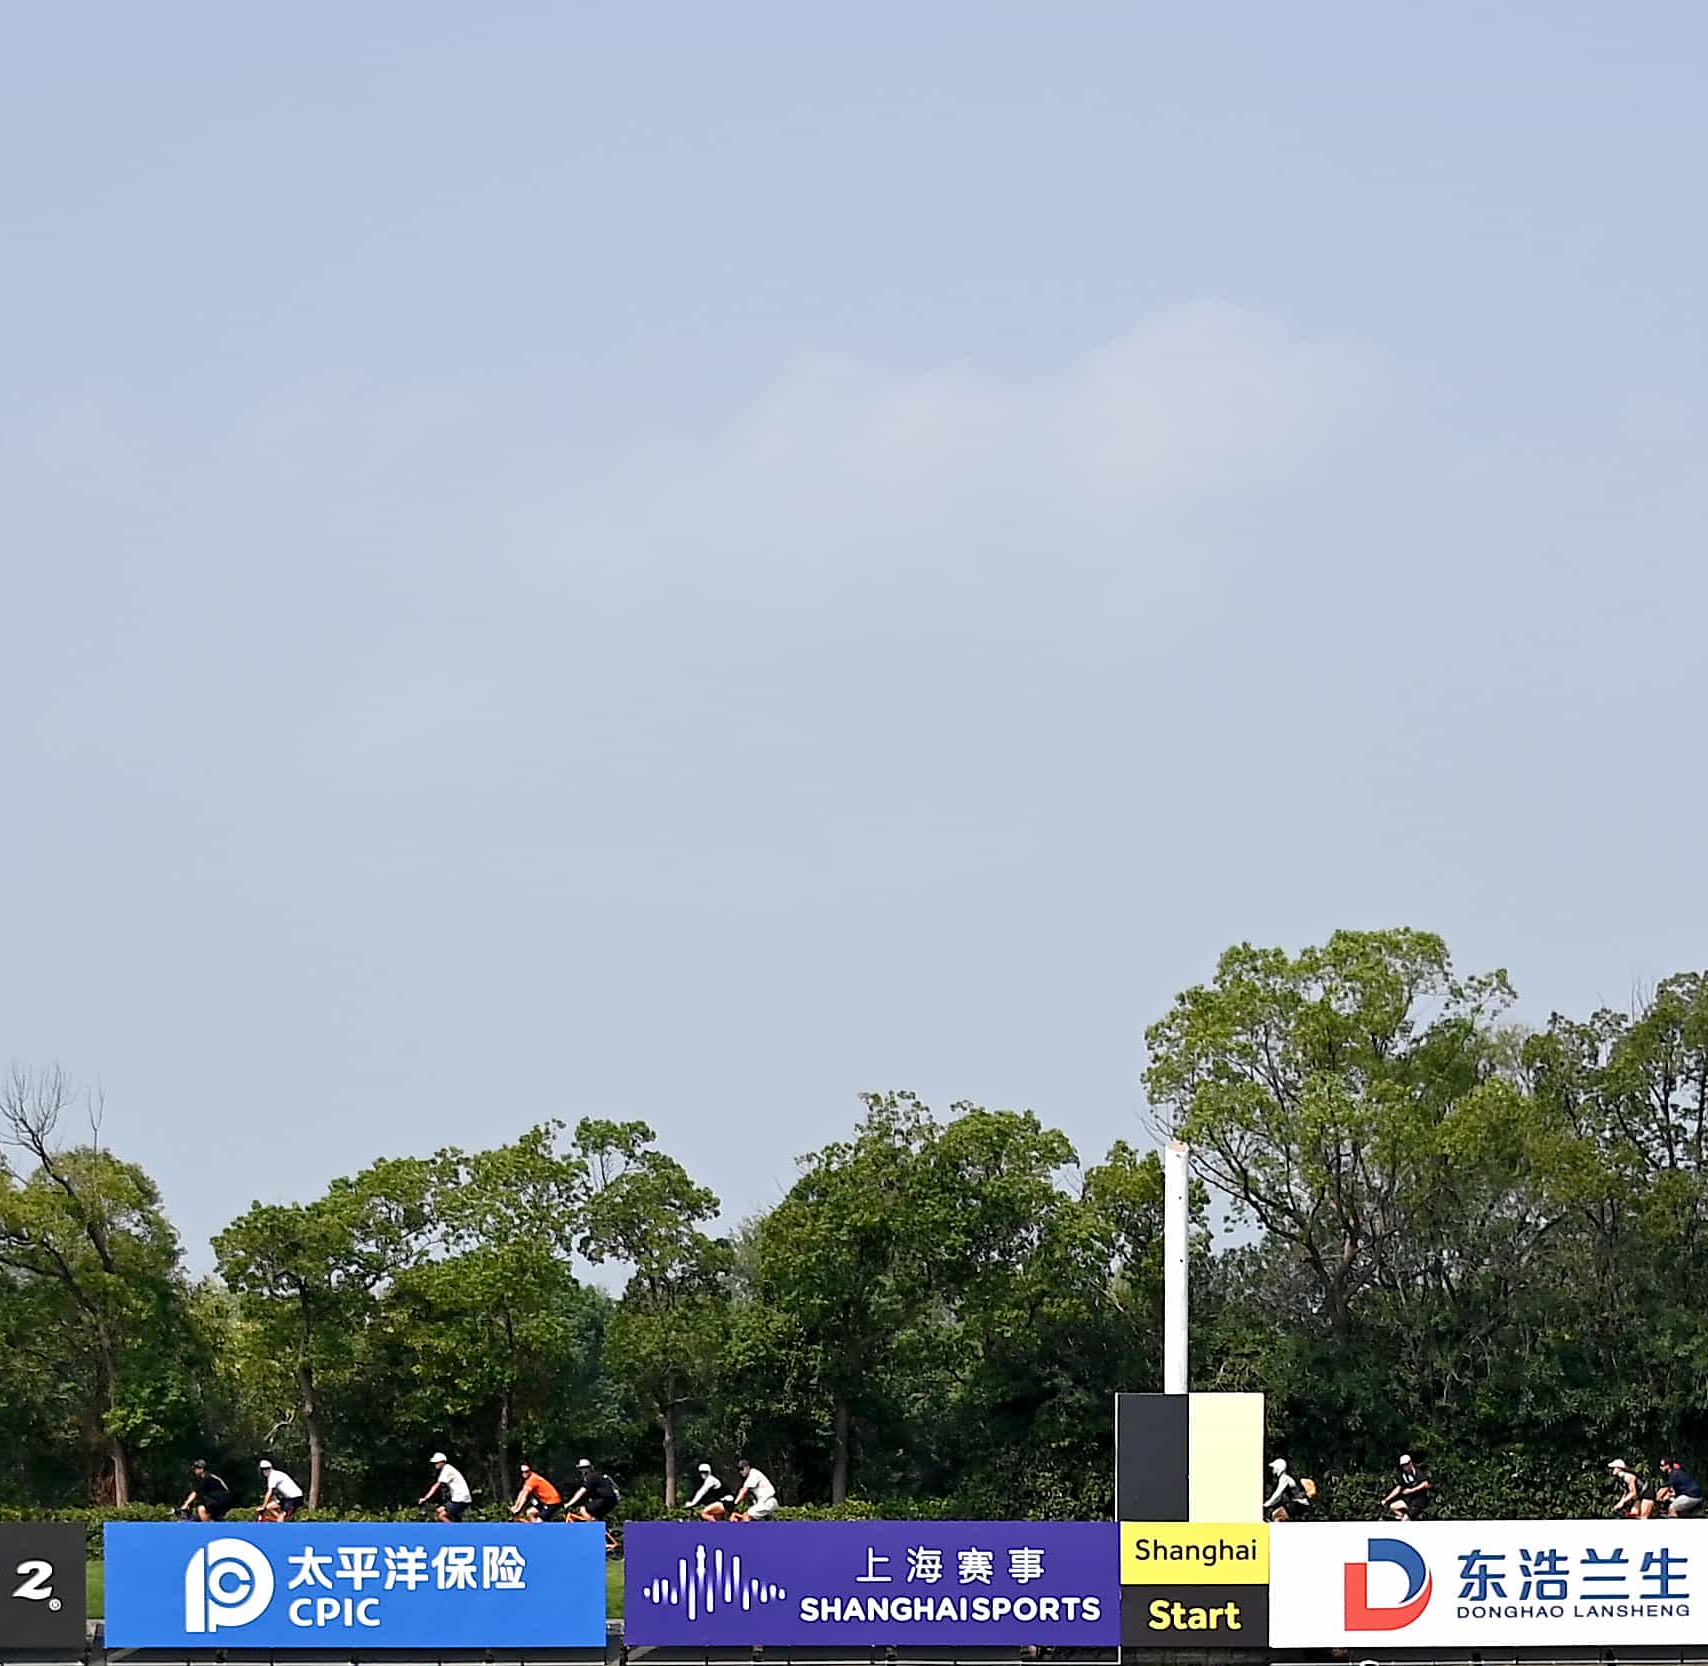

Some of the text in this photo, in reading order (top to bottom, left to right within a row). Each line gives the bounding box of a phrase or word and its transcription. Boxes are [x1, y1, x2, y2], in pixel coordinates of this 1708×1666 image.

[289, 1547, 525, 1591] 太平洋保险
[857, 1546, 1044, 1584] 上海赛事
[1135, 1538, 1257, 1567] Shanghai
[12, 1561, 53, 1600] 2
[1458, 1548, 1690, 1601] 东浩兰生
[290, 1598, 380, 1627] CPIC
[1148, 1599, 1242, 1630] Start
[1457, 1605, 1690, 1619] DONGHAO LANSHENG
